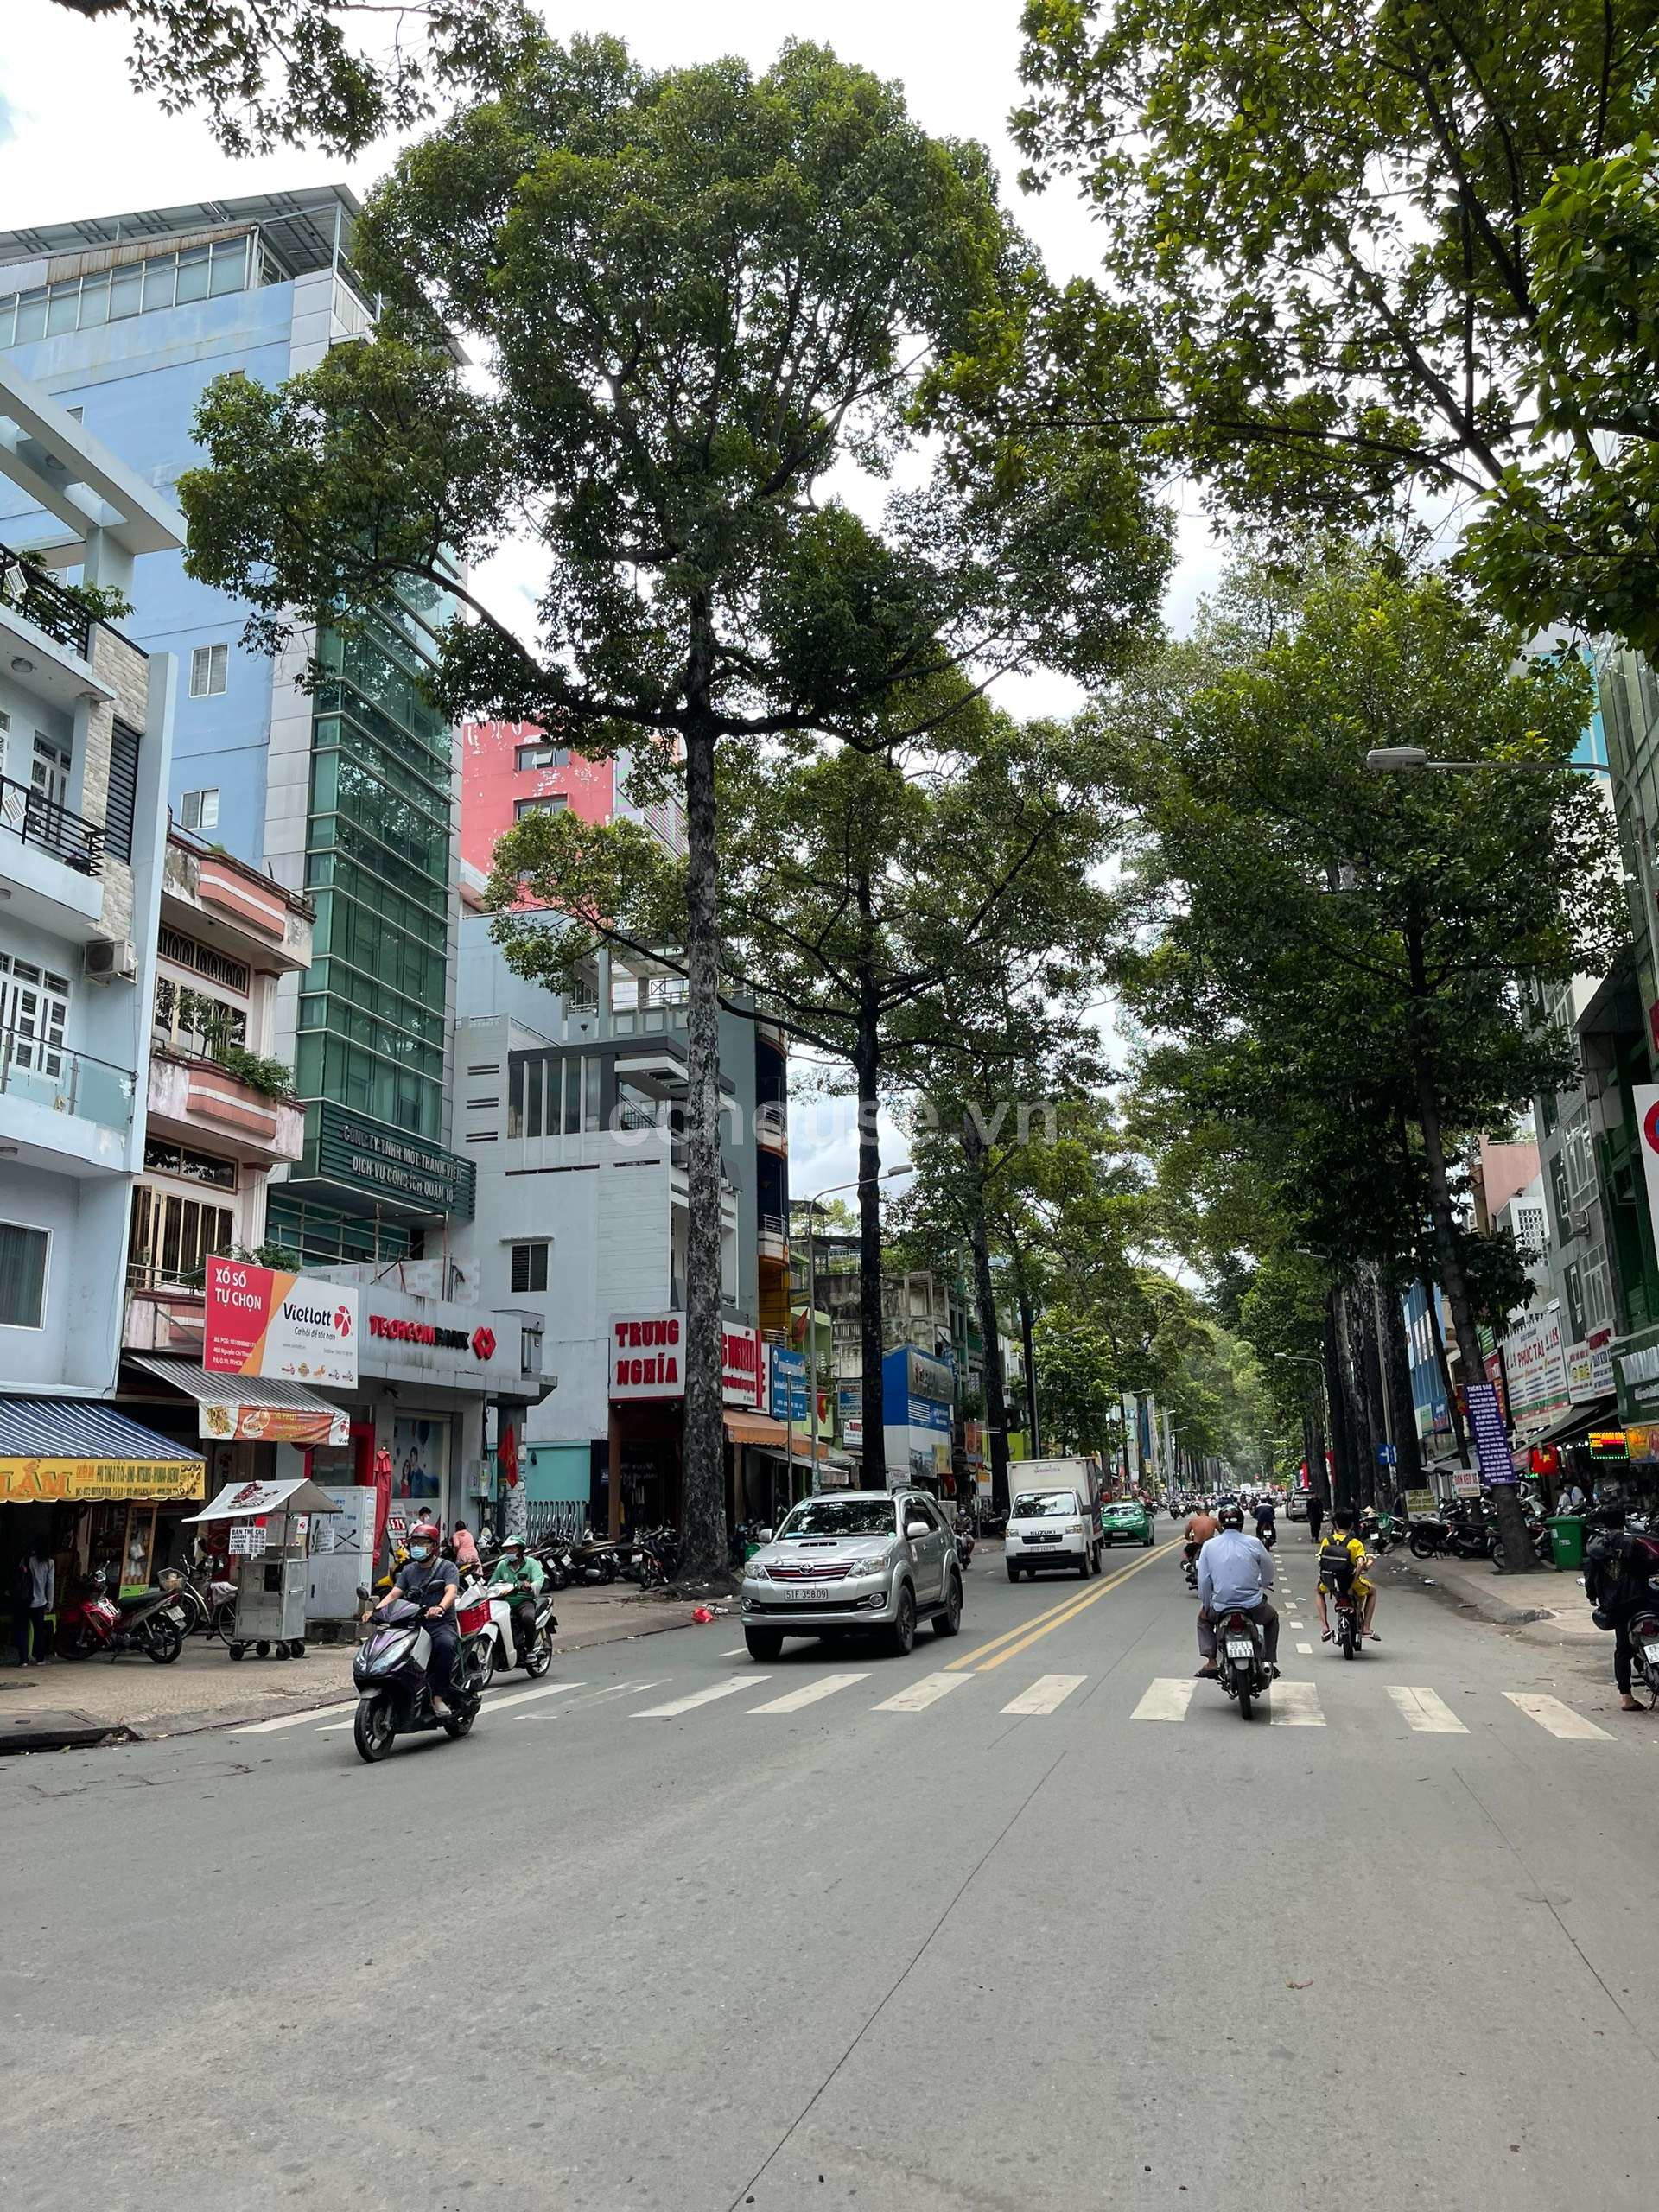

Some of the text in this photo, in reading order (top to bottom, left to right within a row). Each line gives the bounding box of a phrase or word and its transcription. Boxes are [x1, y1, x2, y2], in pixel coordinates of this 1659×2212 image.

[381, 1139, 401, 1159] TNHH
[403, 1146, 421, 1167] MỘT
[353, 1155, 372, 1176] DỊCH
[374, 1161, 385, 1183] VỤ
[424, 1180, 444, 1203] QUẬN
[215, 1266, 247, 1287] XỔ SỐ
[214, 1287, 262, 1312] TỰ CHỌN
[283, 1302, 332, 1327] Vietlott
[369, 1313, 470, 1351] TECHCOMBANK
[614, 1319, 680, 1348] TRUNG
[616, 1352, 678, 1386] NGHĨA
[786, 1590, 799, 1599] 51F
